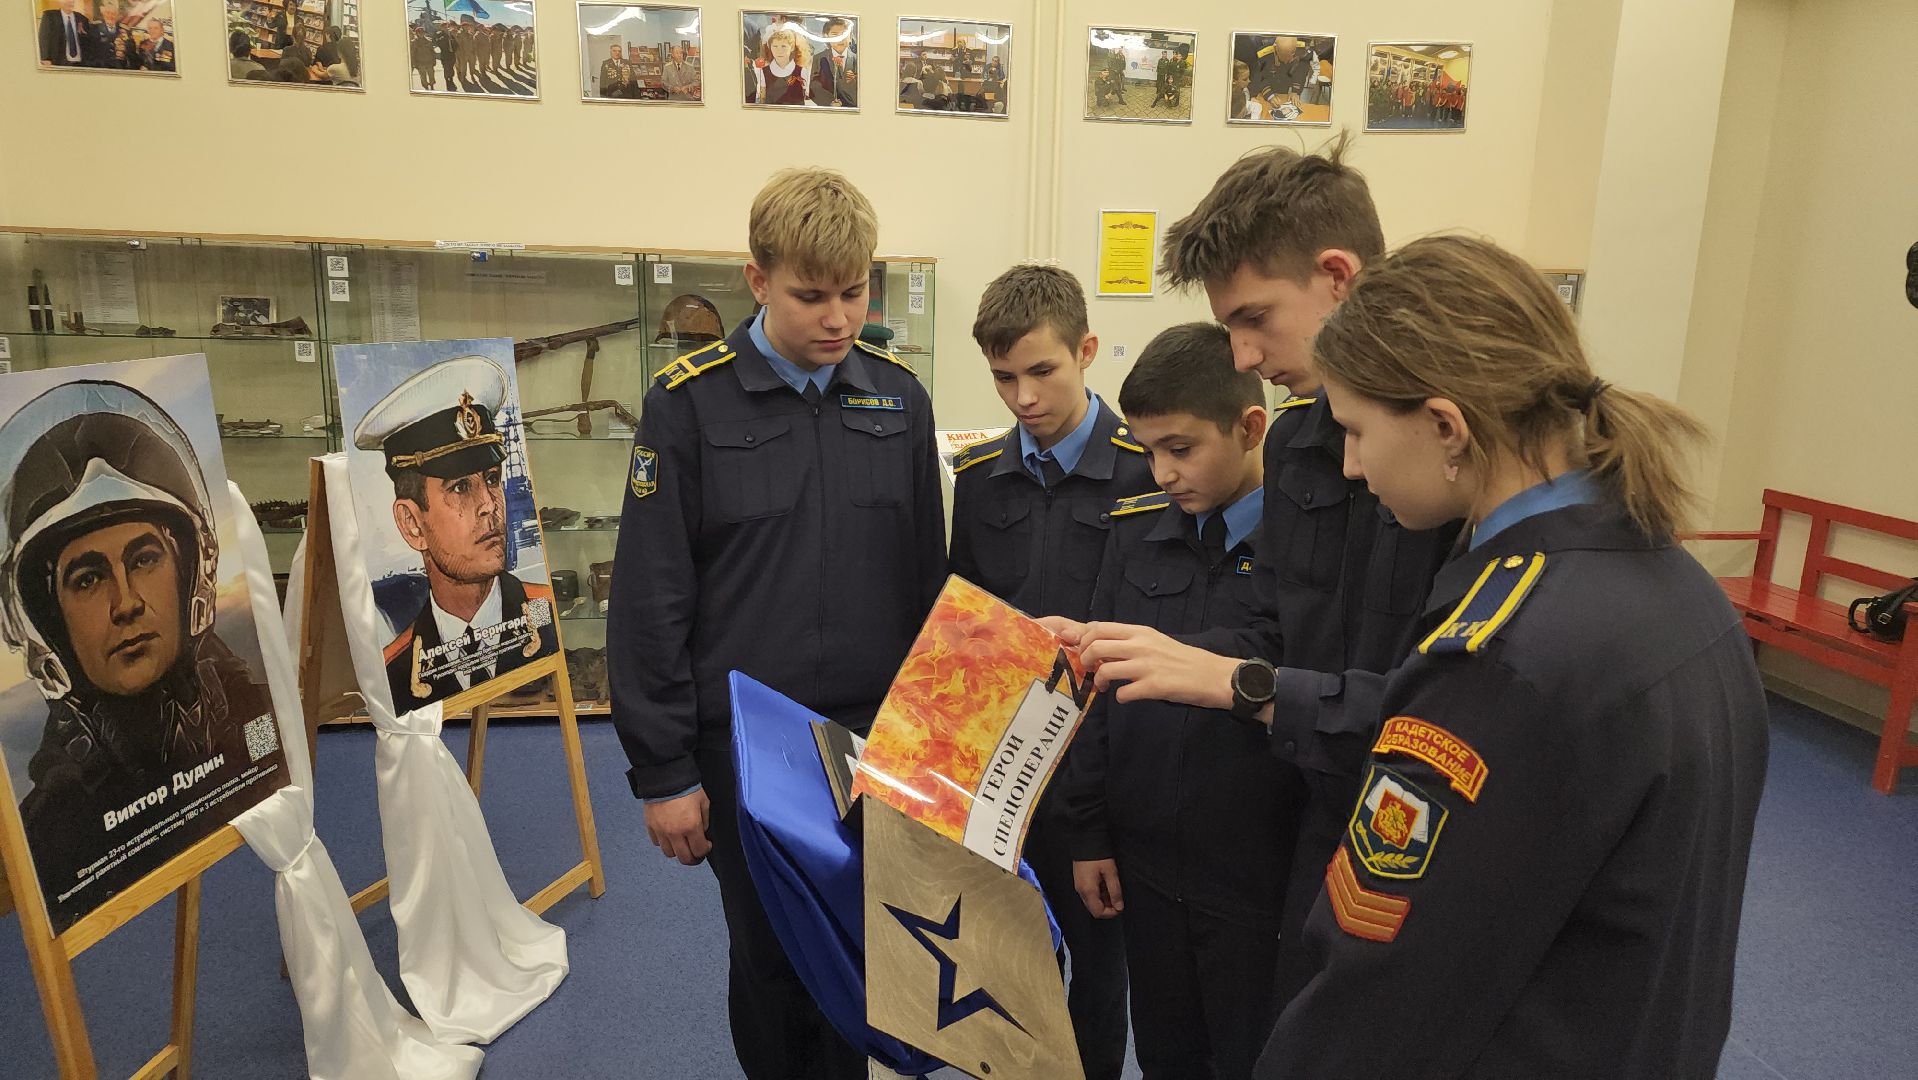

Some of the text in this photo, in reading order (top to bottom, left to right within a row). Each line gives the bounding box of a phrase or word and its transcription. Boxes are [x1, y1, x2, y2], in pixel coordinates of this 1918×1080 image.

[847, 397, 880, 406] БОРИСОВ
[946, 432, 989, 441] КНИГА
[419, 632, 471, 662] Алексей
[1386, 733, 1473, 784] ОБРАЗОВАНИЕ
[1395, 721, 1470, 763] КАДЕТСКОЕ
[982, 733, 1025, 804] ГЕРОИ
[993, 705, 1070, 856] СПЕЦОПЕРАЦИ
[103, 753, 225, 831] Виктор Дудин
[184, 808, 199, 822] ПВО
[108, 844, 126, 859] 23-го
